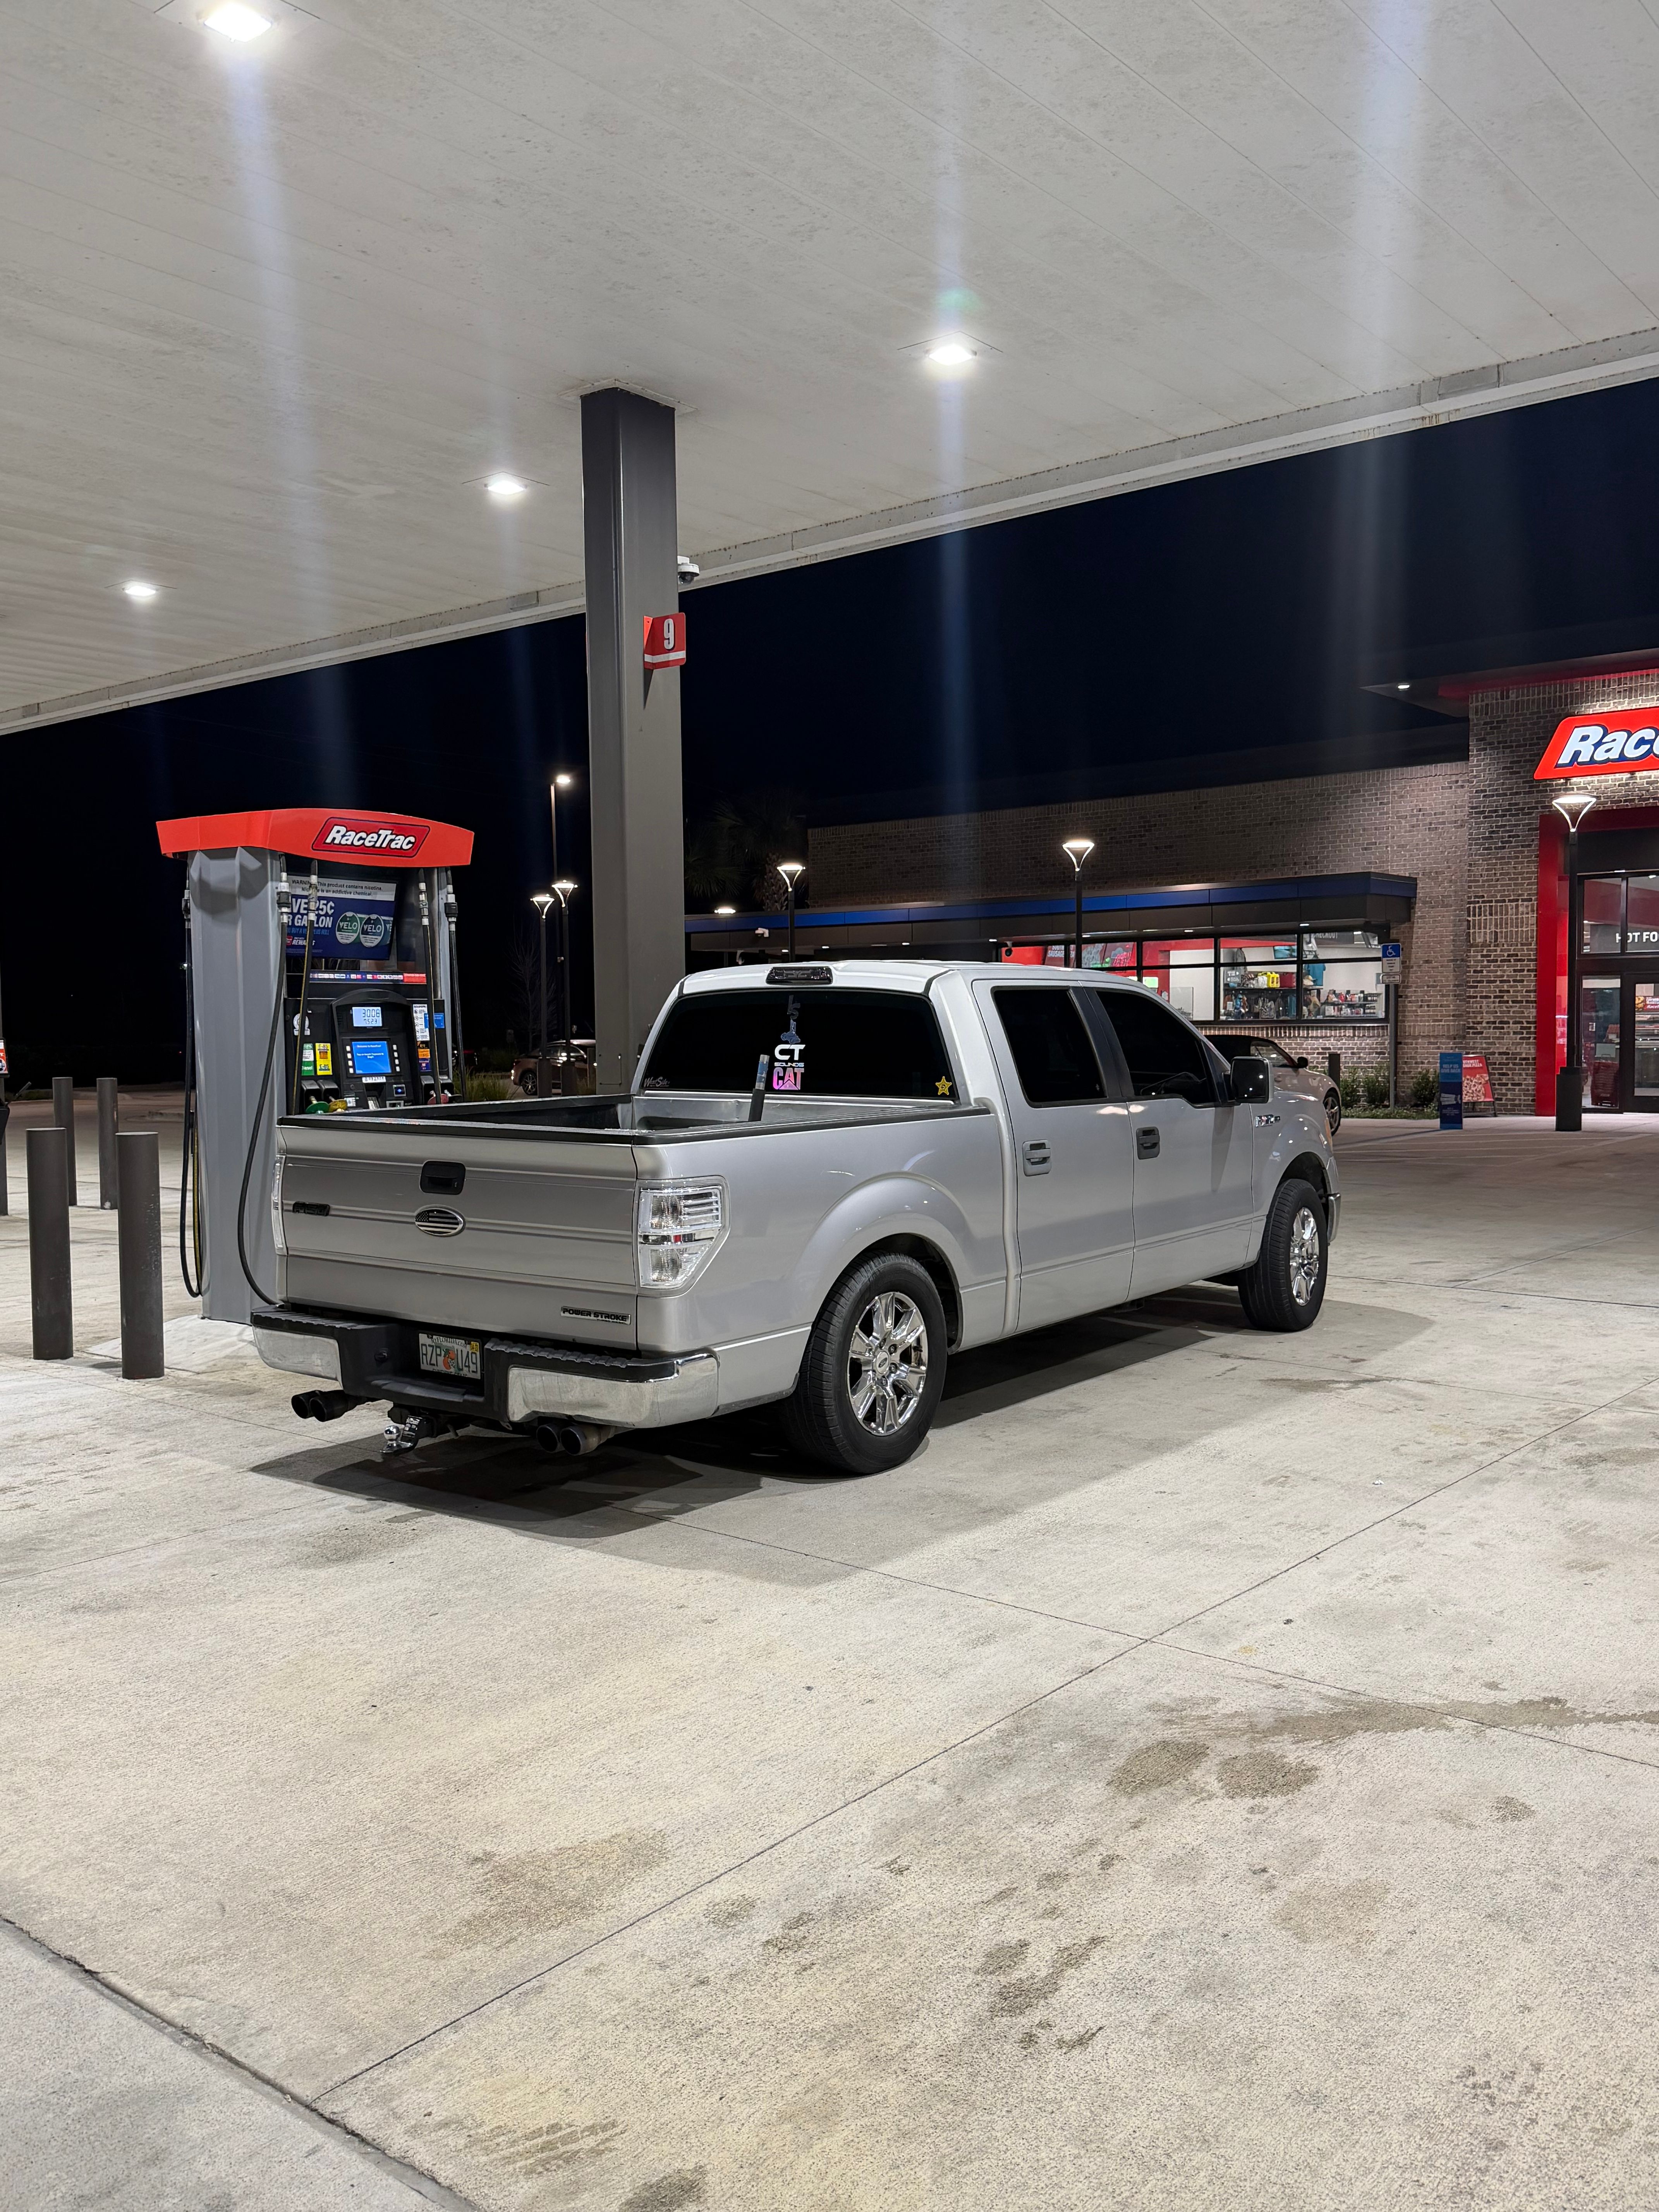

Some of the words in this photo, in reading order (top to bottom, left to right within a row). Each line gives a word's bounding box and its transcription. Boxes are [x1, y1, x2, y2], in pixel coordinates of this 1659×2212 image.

[664, 618, 675, 650] 9
[325, 825, 416, 850] RaceTrac
[290, 898, 308, 914] VE
[294, 914, 333, 927] GALON
[1643, 931, 1659, 942] FO
[775, 1044, 806, 1060] CT
[773, 1067, 805, 1090] CAT
[563, 1308, 591, 1317] POWER
[593, 1312, 627, 1322] STROKE
[421, 1343, 441, 1367] RZP
[457, 1349, 477, 1373] U49
